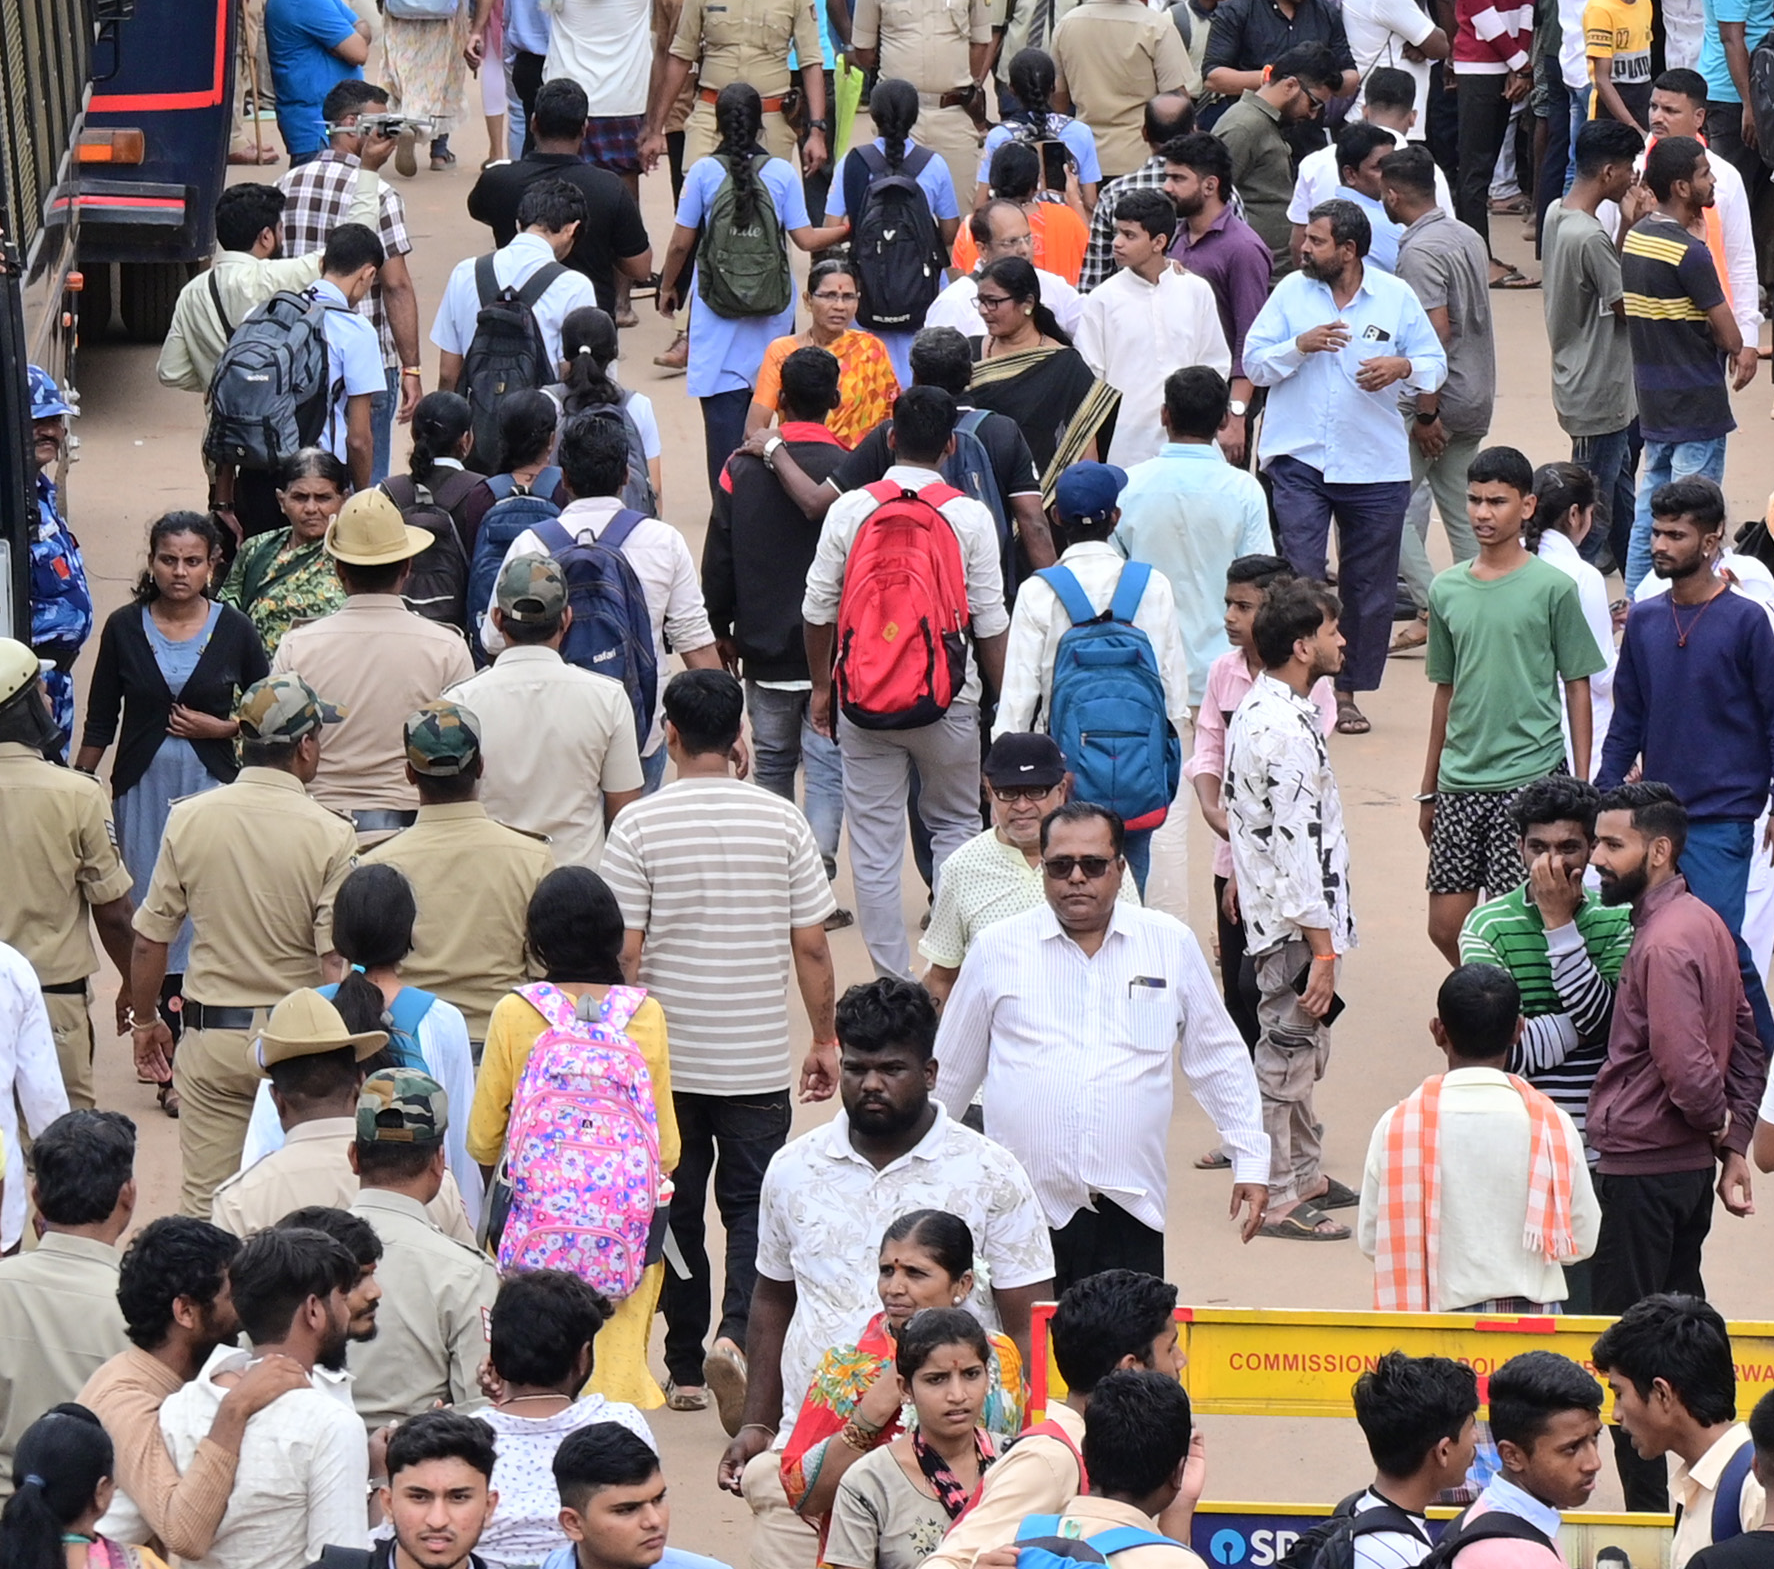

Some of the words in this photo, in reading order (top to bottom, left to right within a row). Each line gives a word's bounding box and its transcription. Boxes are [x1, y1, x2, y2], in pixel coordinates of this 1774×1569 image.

[593, 647, 617, 664] safari
[1228, 1352, 1378, 1374] COMMISSION
[1250, 1530, 1302, 1569] SB
